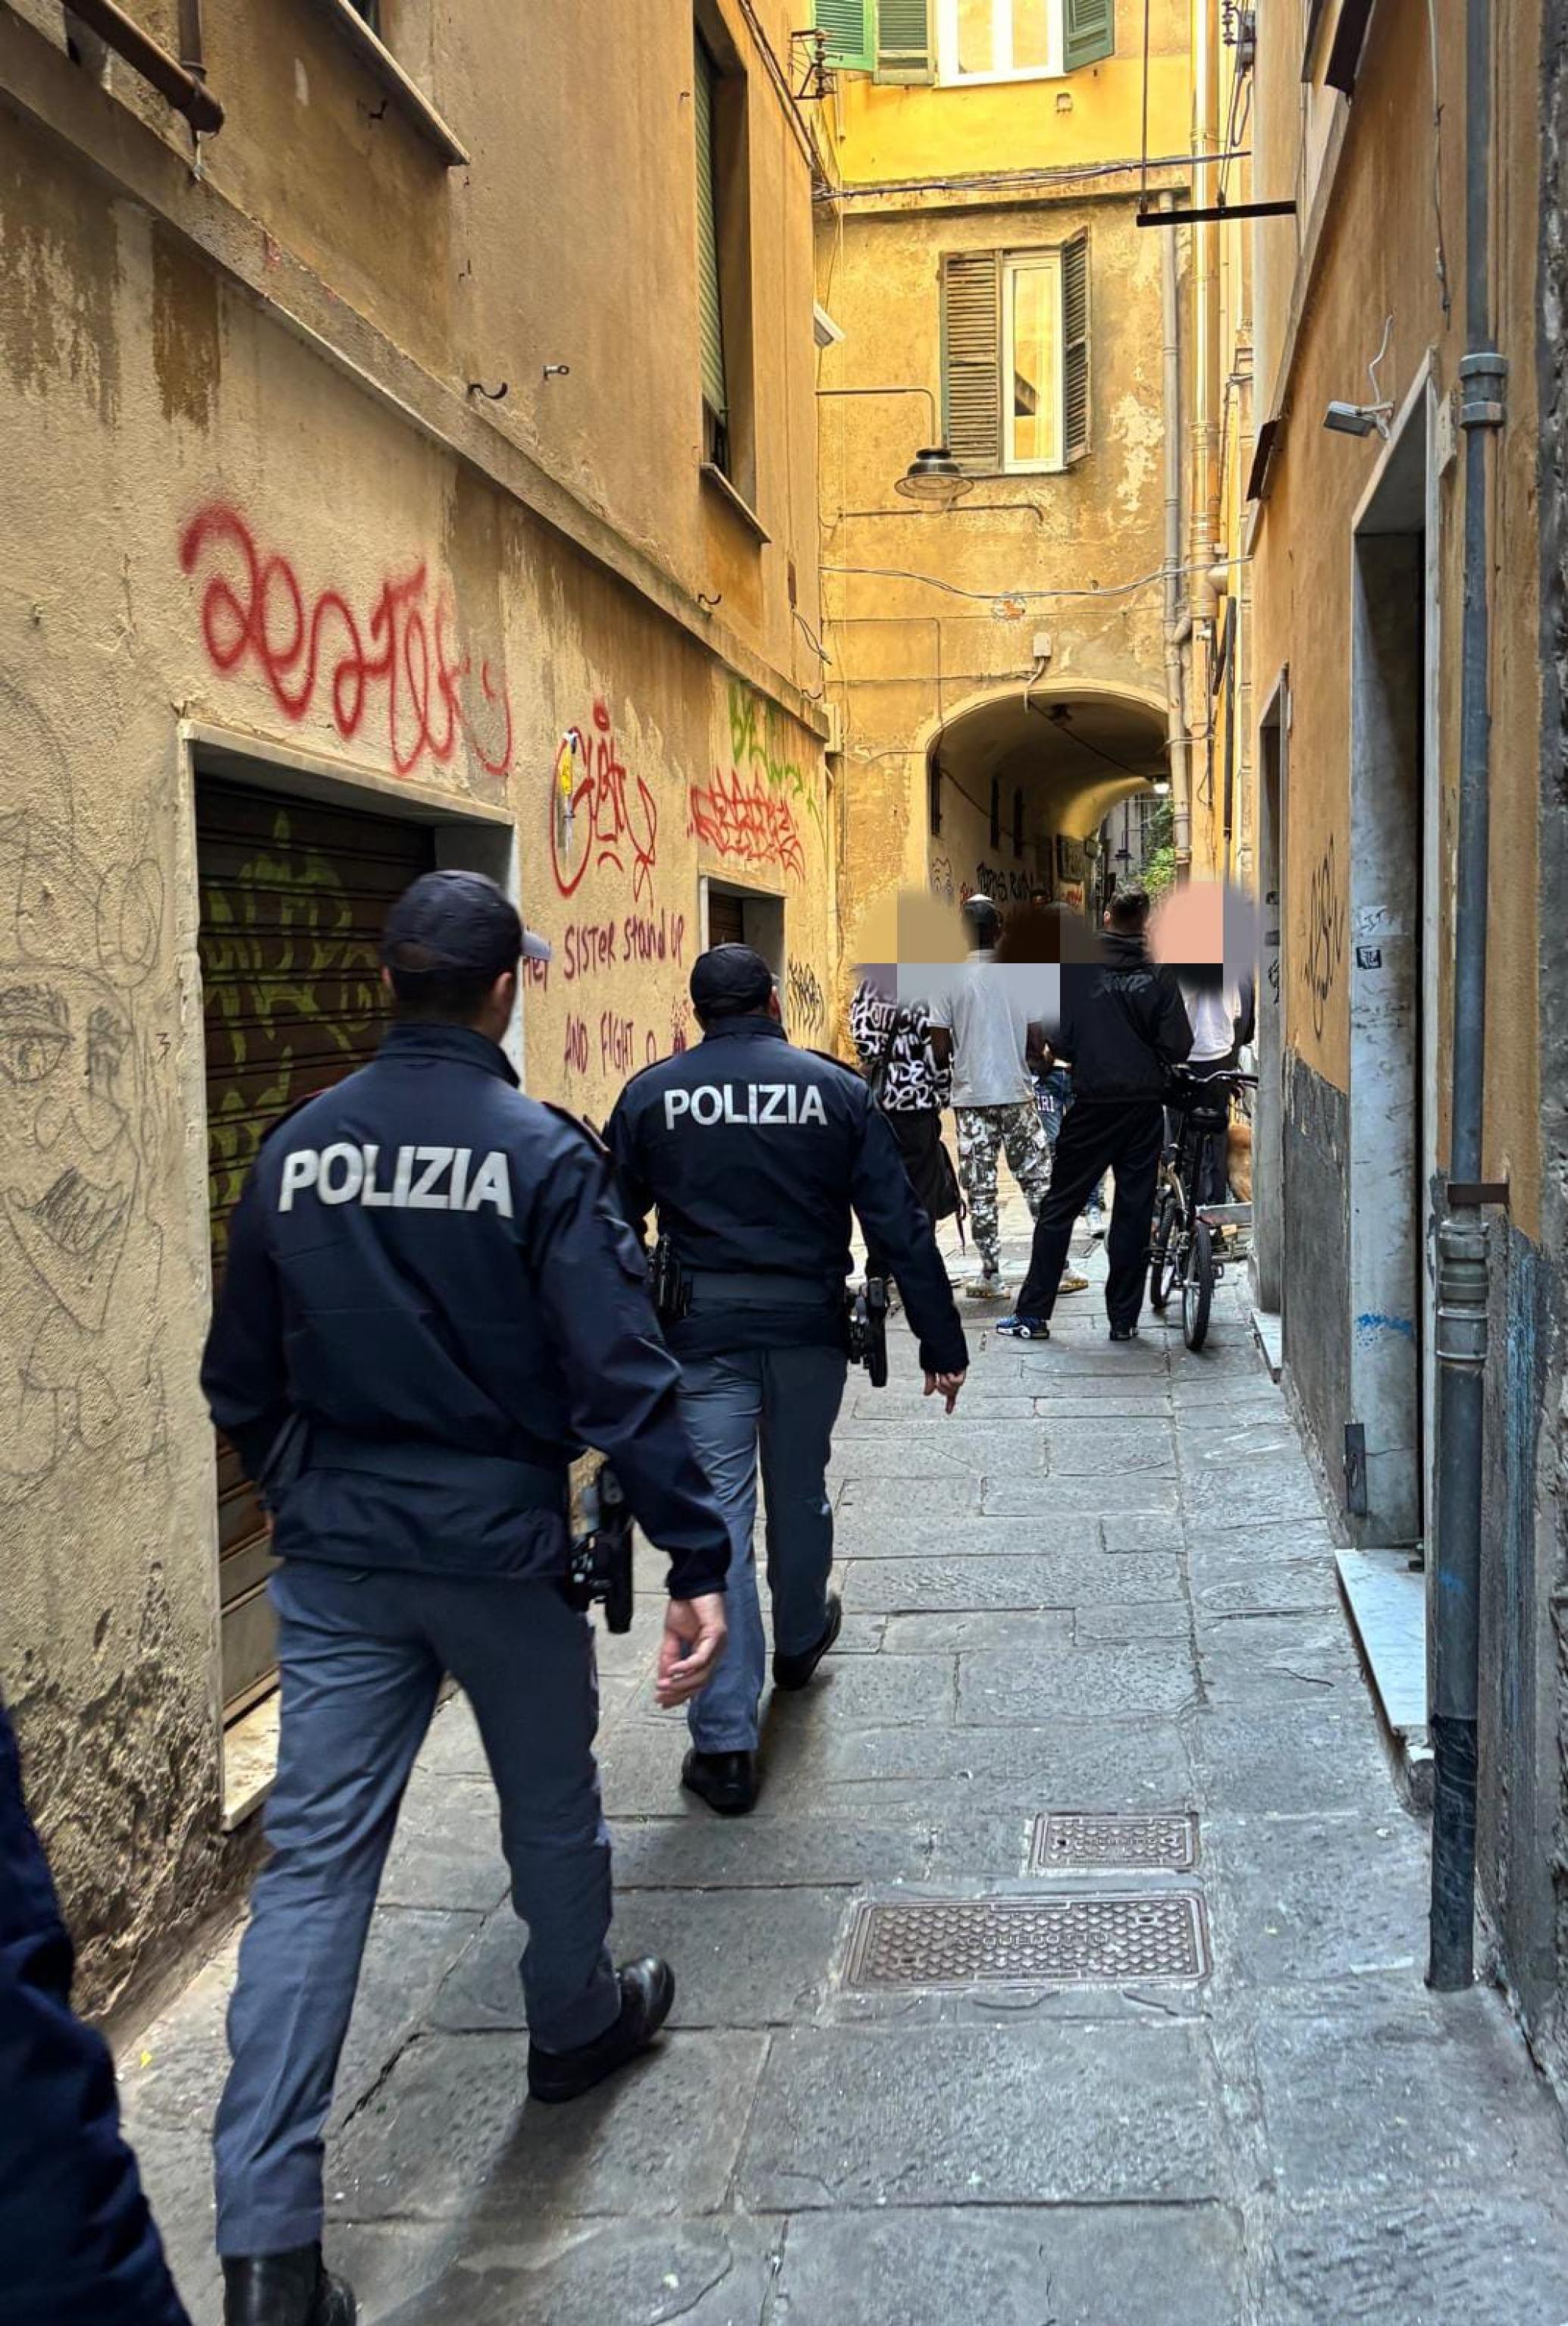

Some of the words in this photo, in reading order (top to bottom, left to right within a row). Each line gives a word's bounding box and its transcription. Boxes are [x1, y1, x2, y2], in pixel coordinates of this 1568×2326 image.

[600, 1010, 634, 1076] FIGHT
[664, 1083, 828, 1130] POLIZIA
[278, 1142, 513, 1218] POLIZIA
